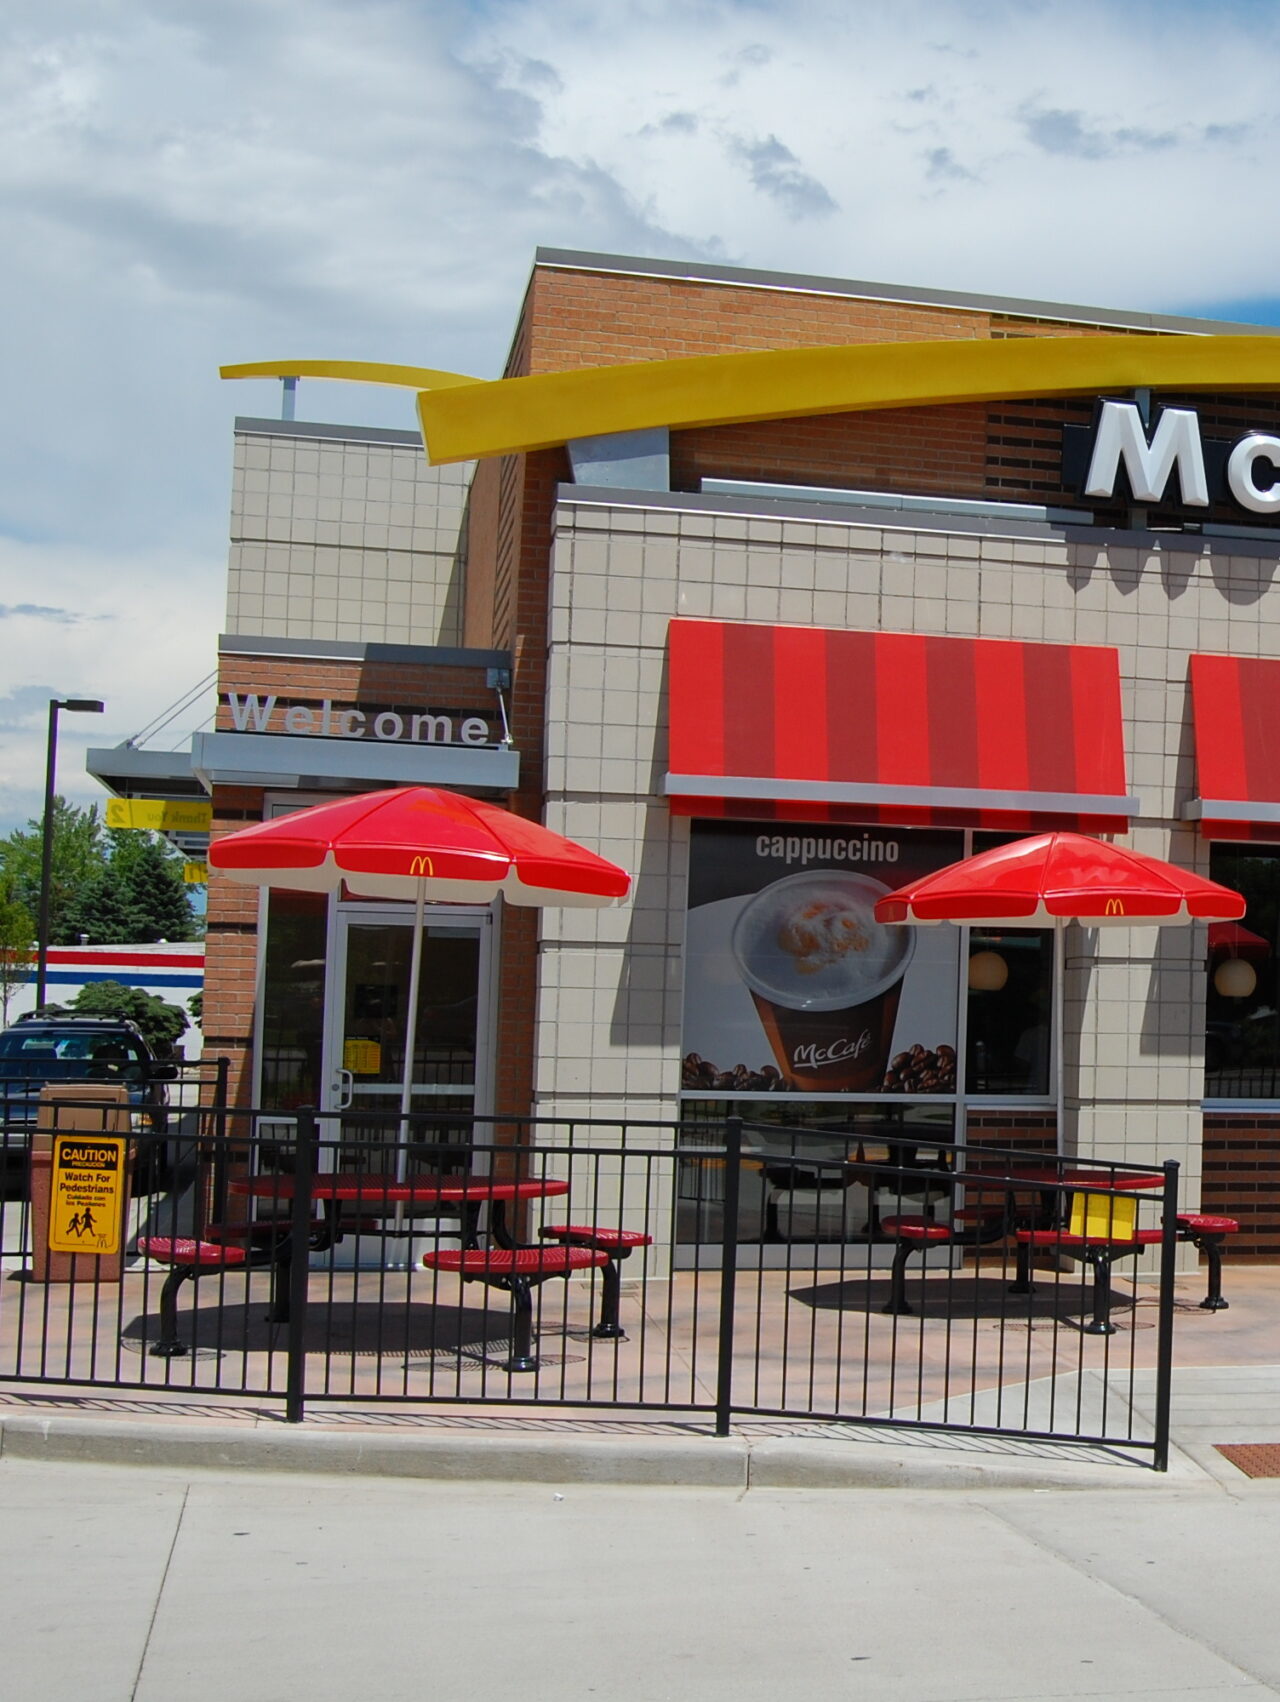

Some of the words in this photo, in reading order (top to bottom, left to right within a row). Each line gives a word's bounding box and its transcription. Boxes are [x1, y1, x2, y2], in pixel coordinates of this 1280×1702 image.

[228, 691, 489, 745] Welcome
[755, 833, 899, 865] cappuccino
[62, 1148, 117, 1162] CAUTION
[64, 1172, 93, 1182] Watch
[96, 1173, 111, 1183] For
[59, 1183, 114, 1194] Pedestrians
